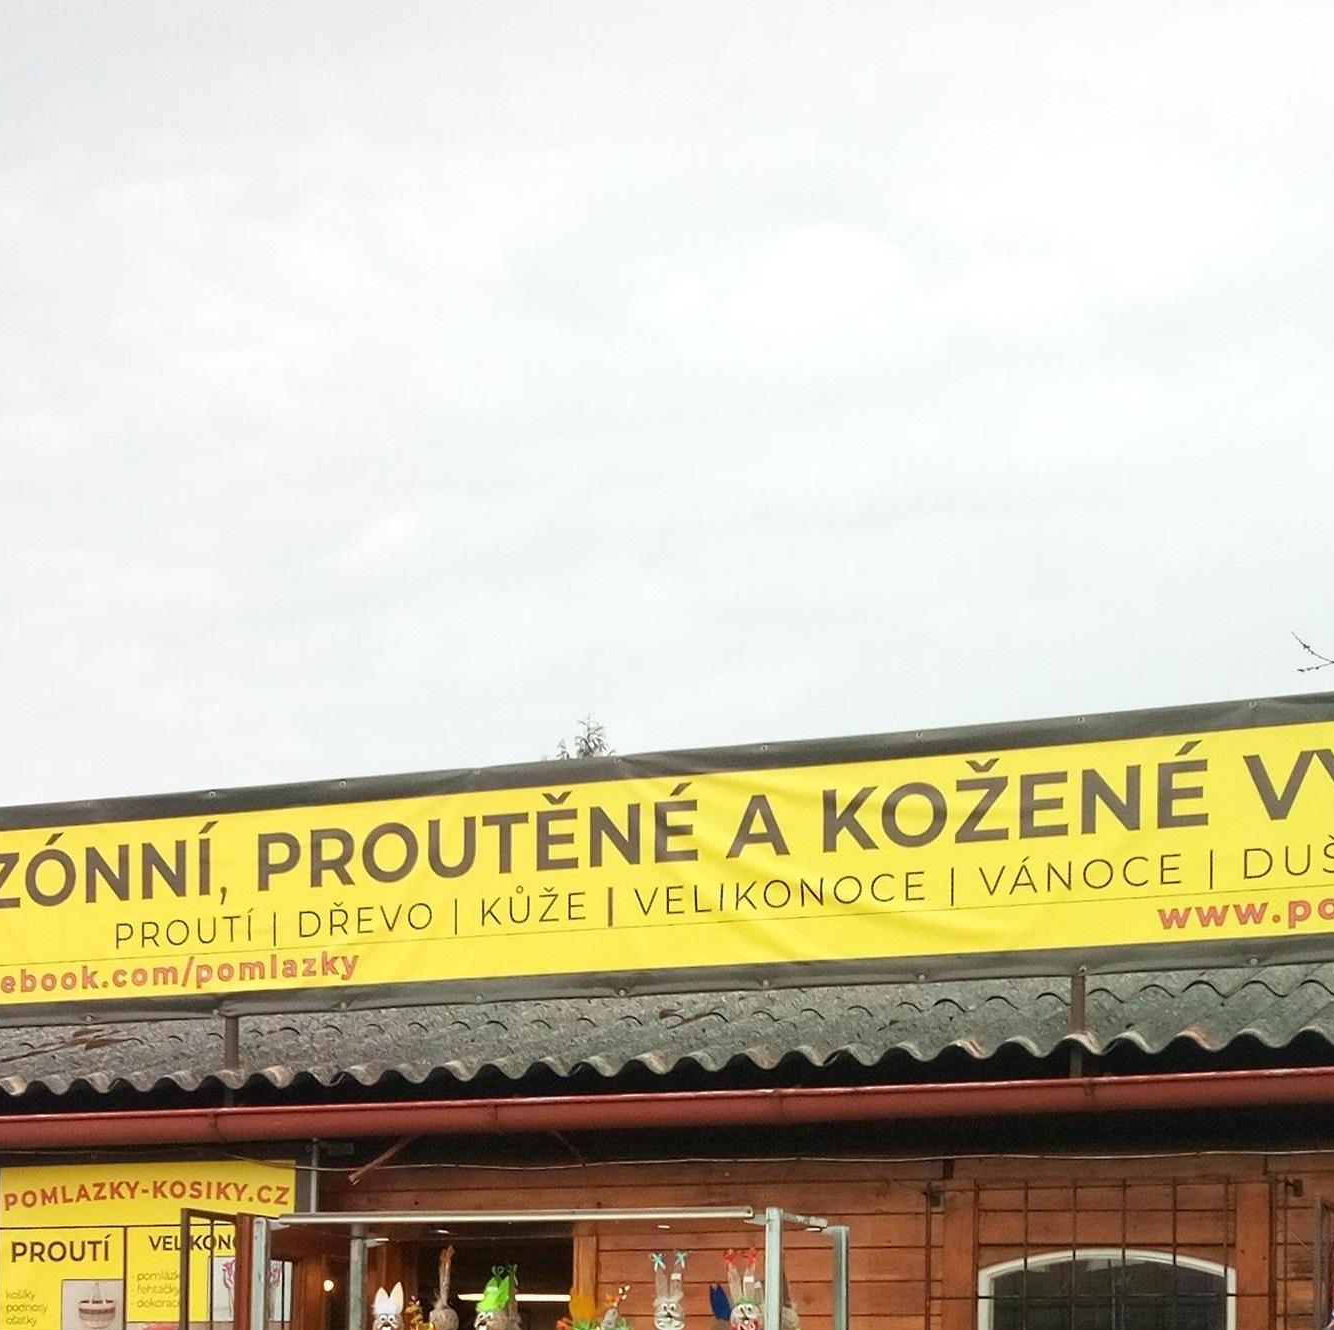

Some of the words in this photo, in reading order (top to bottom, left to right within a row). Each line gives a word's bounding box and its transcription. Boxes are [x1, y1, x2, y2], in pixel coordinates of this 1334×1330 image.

[257, 782, 699, 891] PROUTĚNÉ
[725, 794, 791, 860] A
[822, 739, 1209, 853] KOŽENÉ
[115, 908, 255, 950] PROUTÍ
[298, 902, 433, 938] DŘEVO
[481, 885, 587, 927] KŮŽE
[633, 871, 926, 917] VELIKONOCE
[978, 854, 1182, 896] VÁNOCE
[3, 1180, 291, 1212] POMLAZKY-KOSIKY.CZ
[11, 1233, 113, 1263] PROUTÍ
